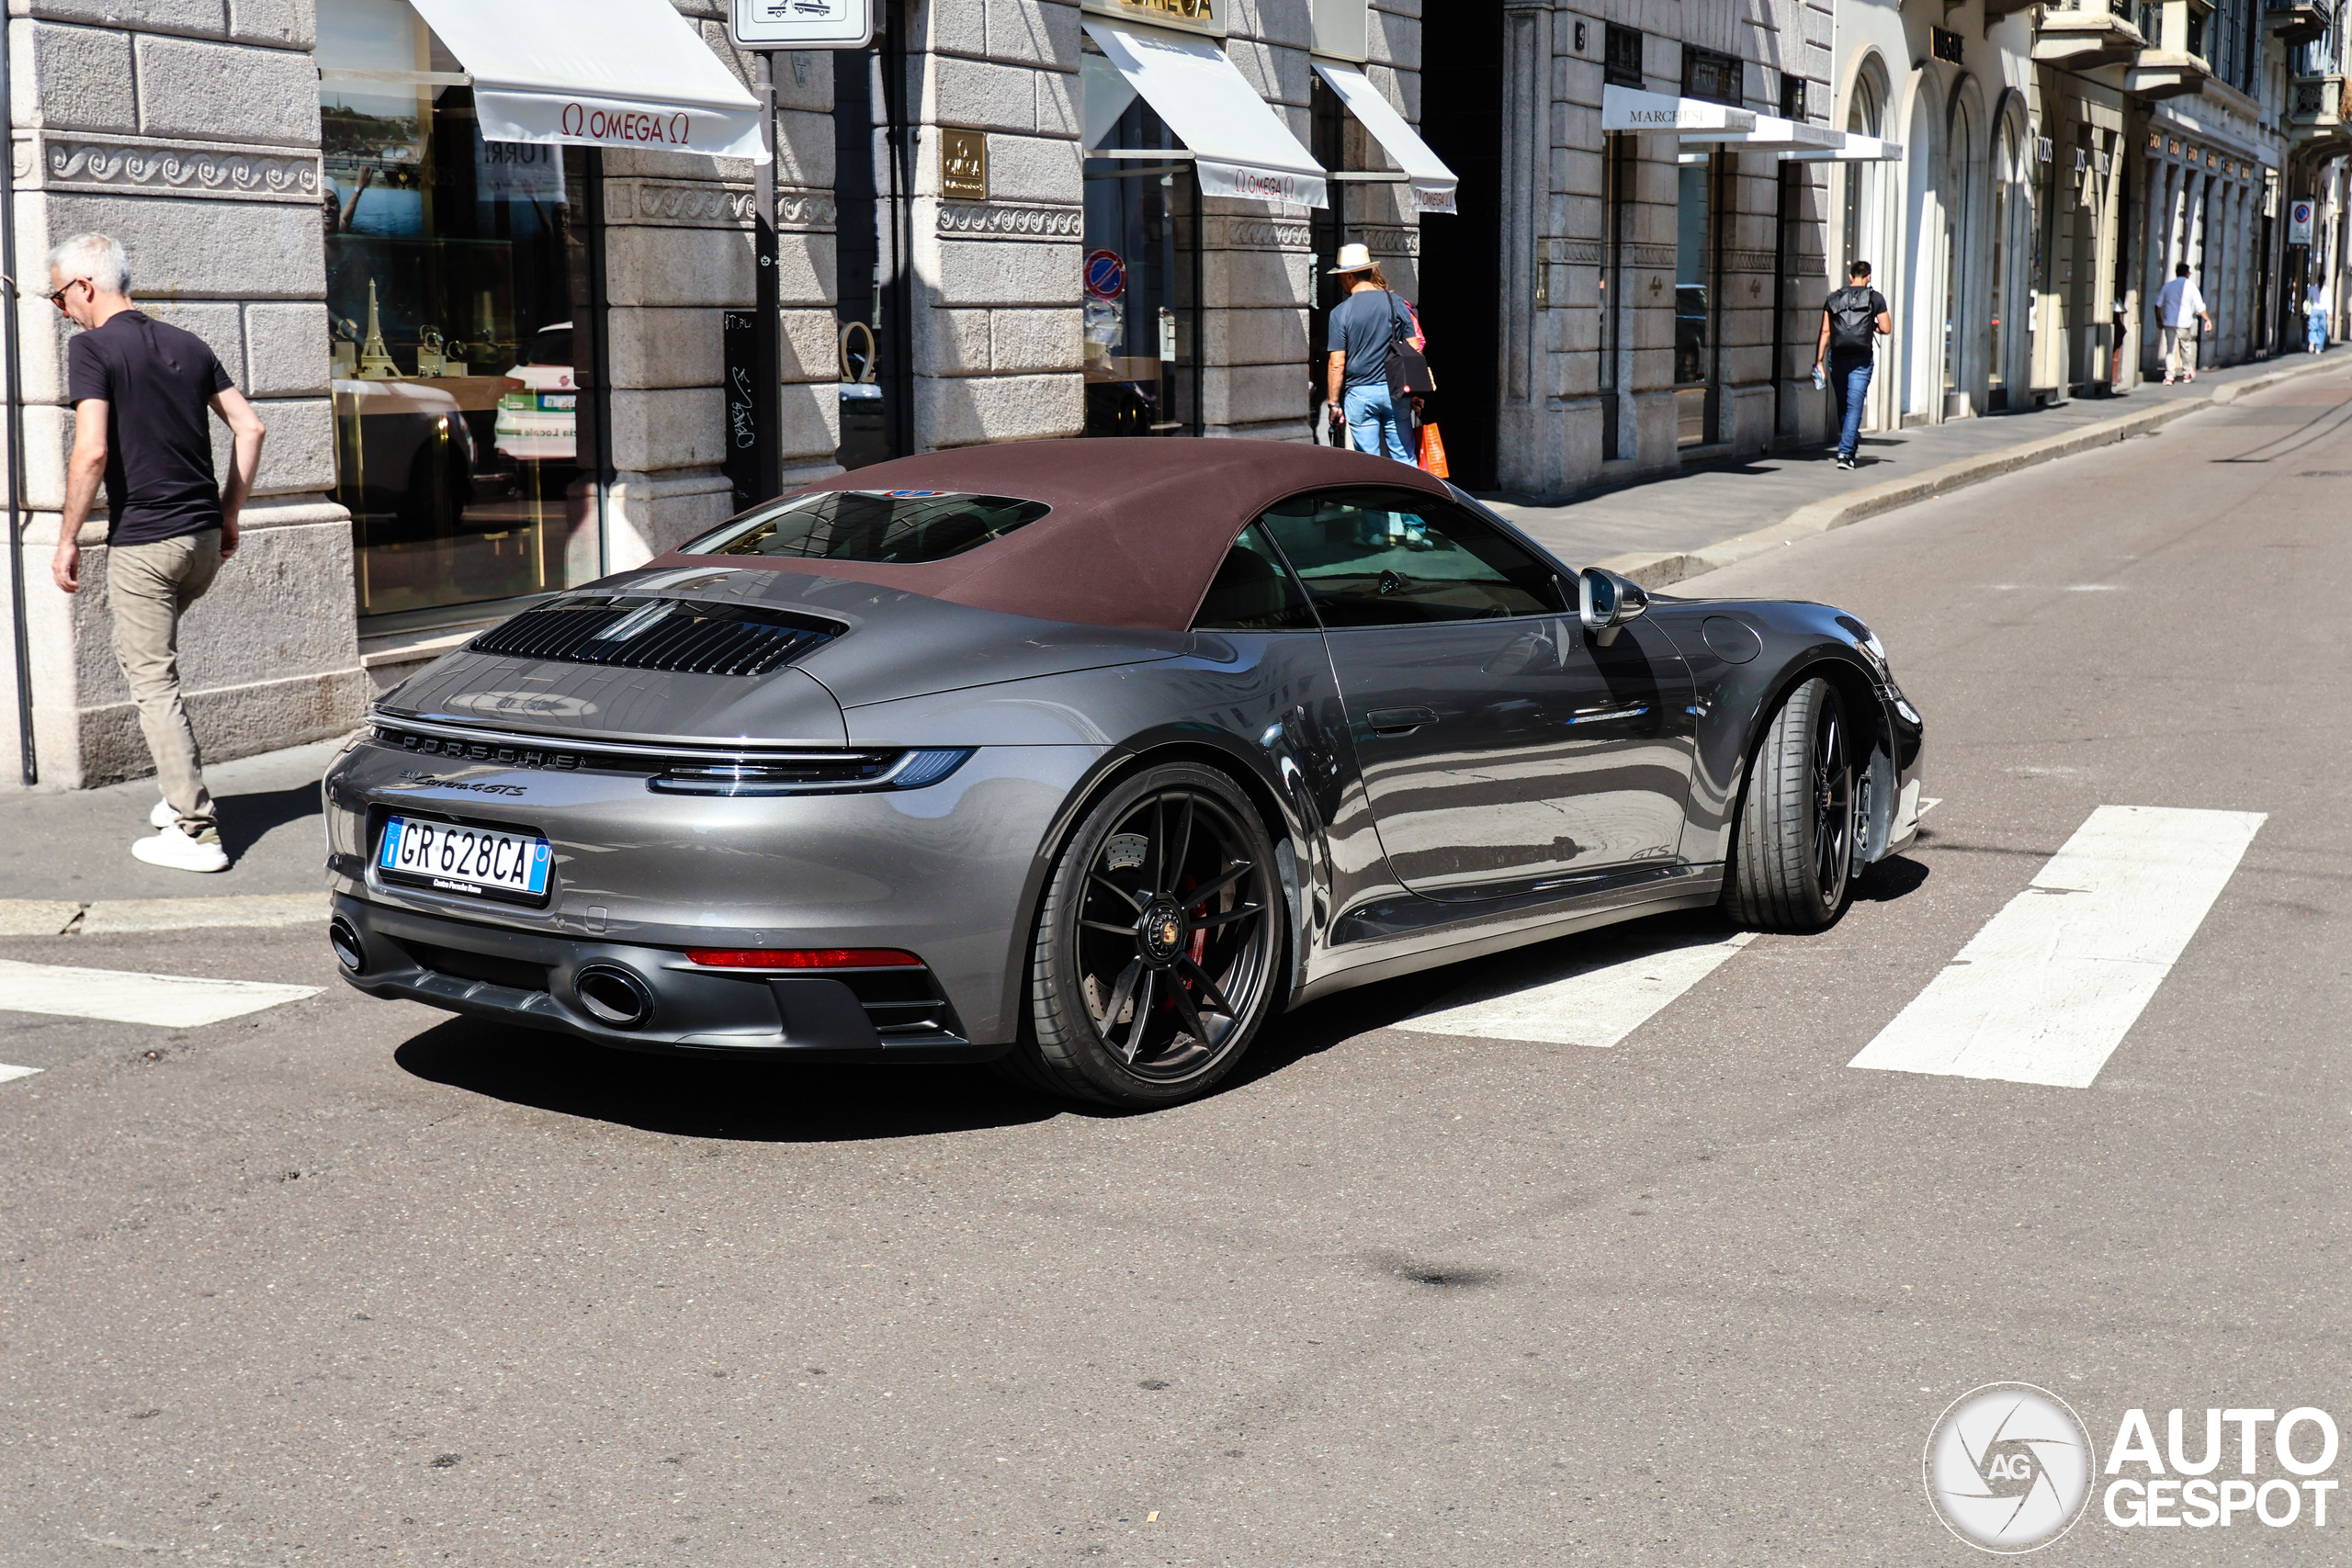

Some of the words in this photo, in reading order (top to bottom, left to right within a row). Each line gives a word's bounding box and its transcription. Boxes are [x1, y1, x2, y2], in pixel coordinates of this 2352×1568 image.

[590, 110, 663, 142] OMEGA
[1630, 110, 1704, 123] MARCHESI
[1248, 175, 1283, 197] OMEGA
[1423, 192, 1446, 207] OMEGA
[403, 736, 576, 769] PORSCHE
[413, 774, 469, 790] Carrera
[401, 823, 435, 868] GR
[441, 829, 526, 885] 628CA
